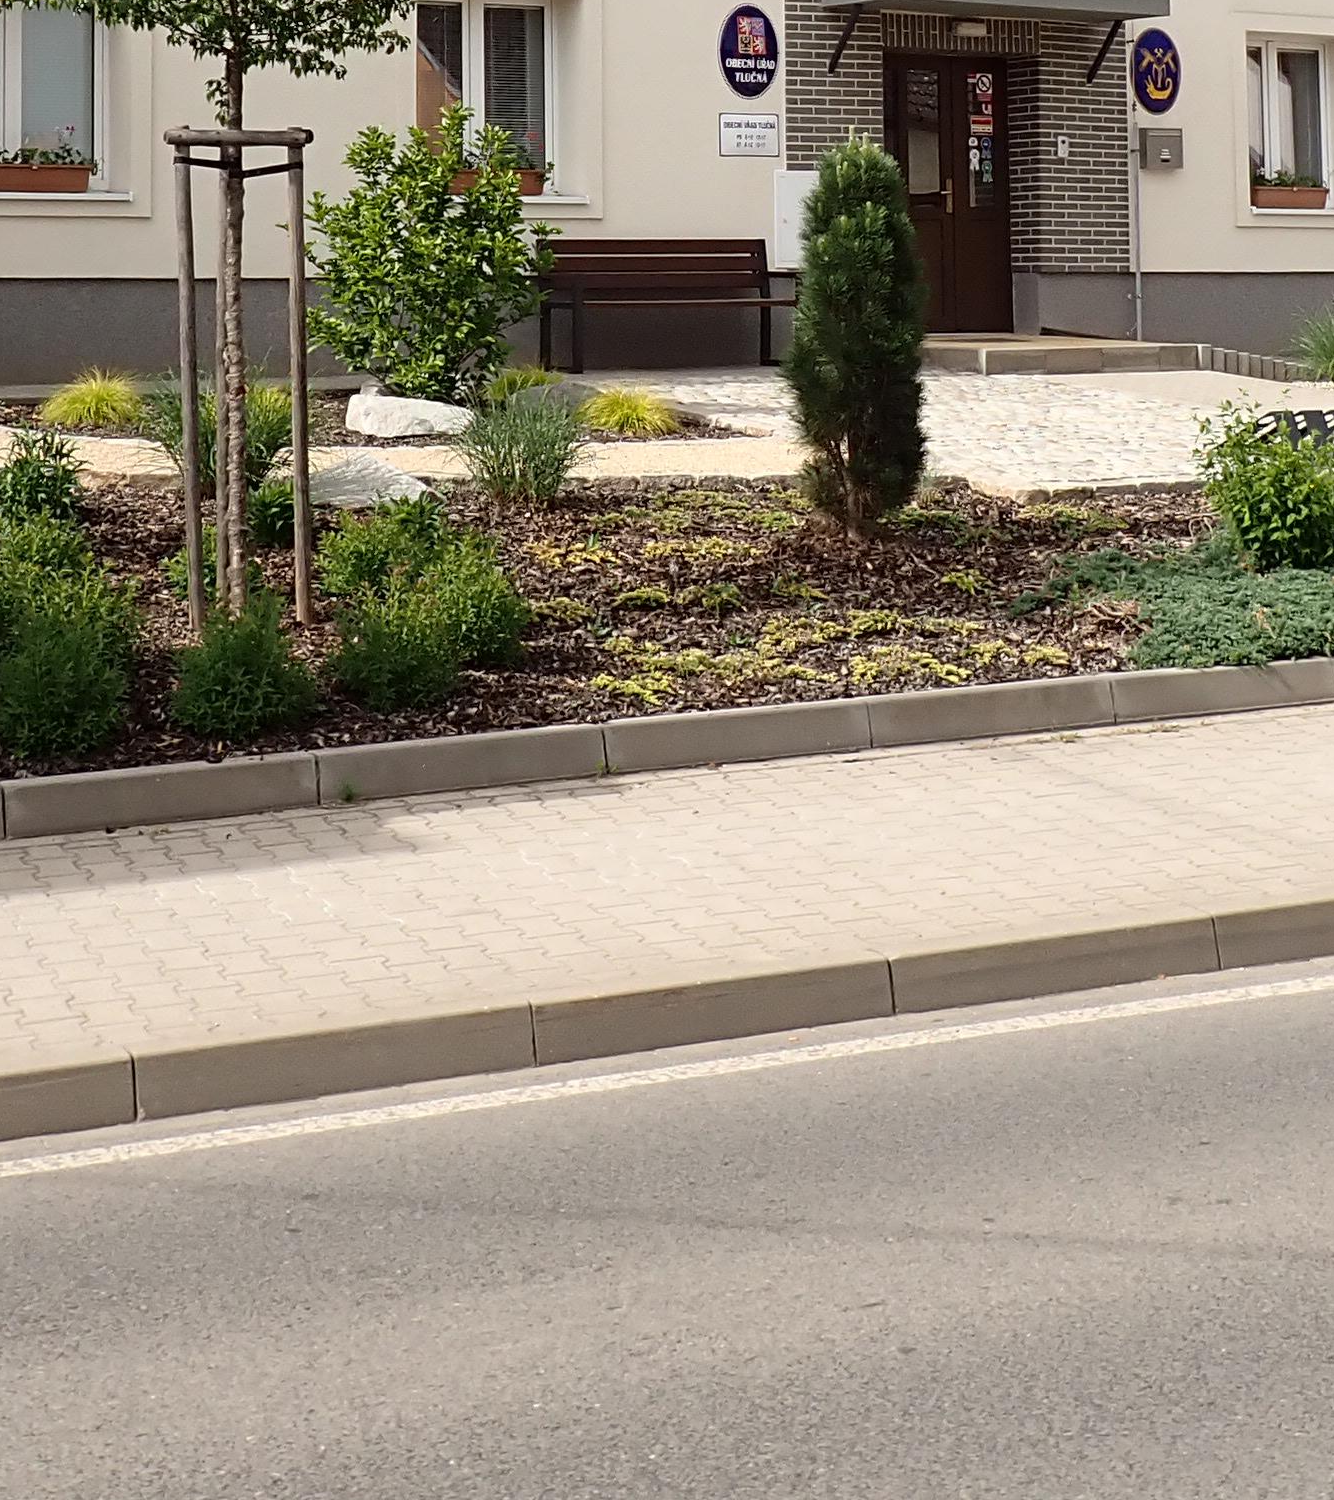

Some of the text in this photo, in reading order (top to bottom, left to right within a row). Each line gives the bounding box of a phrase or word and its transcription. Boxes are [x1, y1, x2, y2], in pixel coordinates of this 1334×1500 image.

[725, 56, 776, 70] OBECNÍ ÚŘAD
[734, 70, 768, 83] TLUČNÁ
